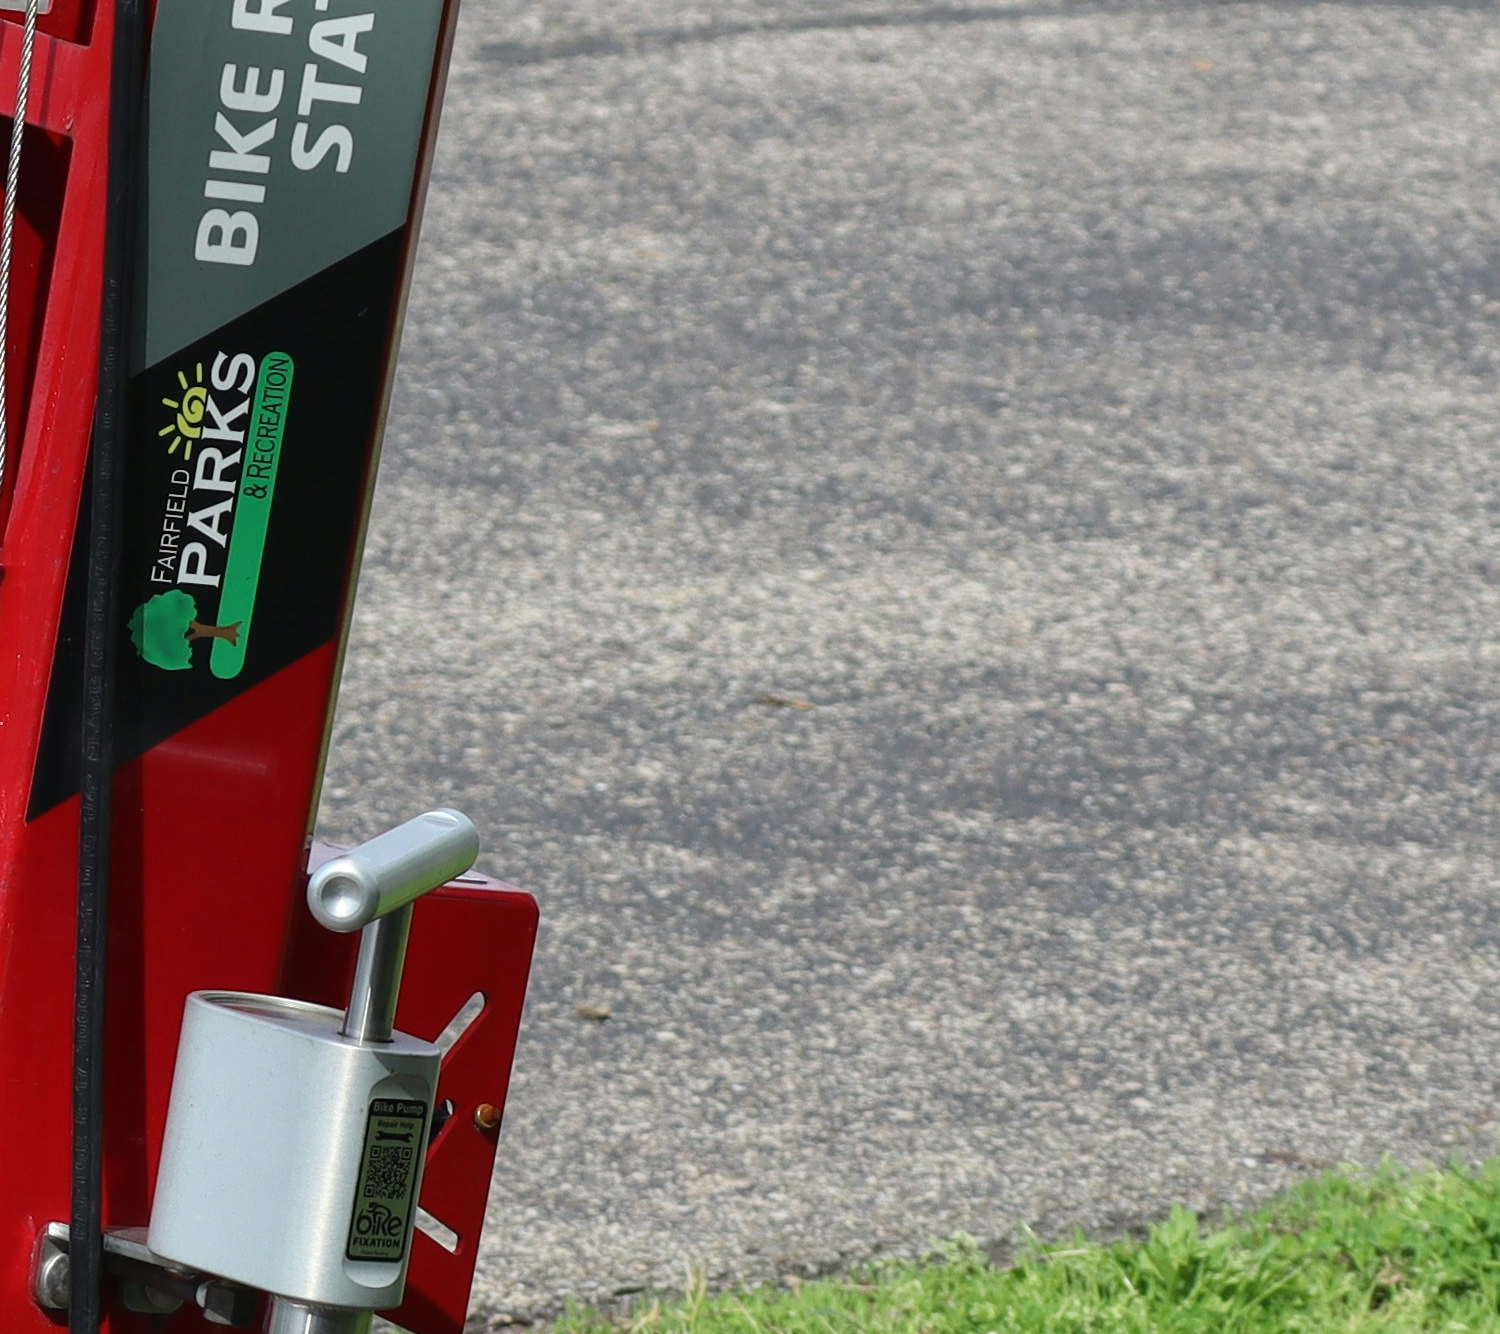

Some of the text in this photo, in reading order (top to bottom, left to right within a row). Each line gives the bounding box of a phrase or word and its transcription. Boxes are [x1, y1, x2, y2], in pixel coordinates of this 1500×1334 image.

[194, 63, 286, 267] BIKE
[176, 349, 257, 588] PARKS
[242, 357, 291, 500] & RECREATION
[150, 468, 190, 585] FAIRFIELD
[373, 1101, 423, 1116] Bike Pump
[353, 1237, 400, 1248] FIXATION
